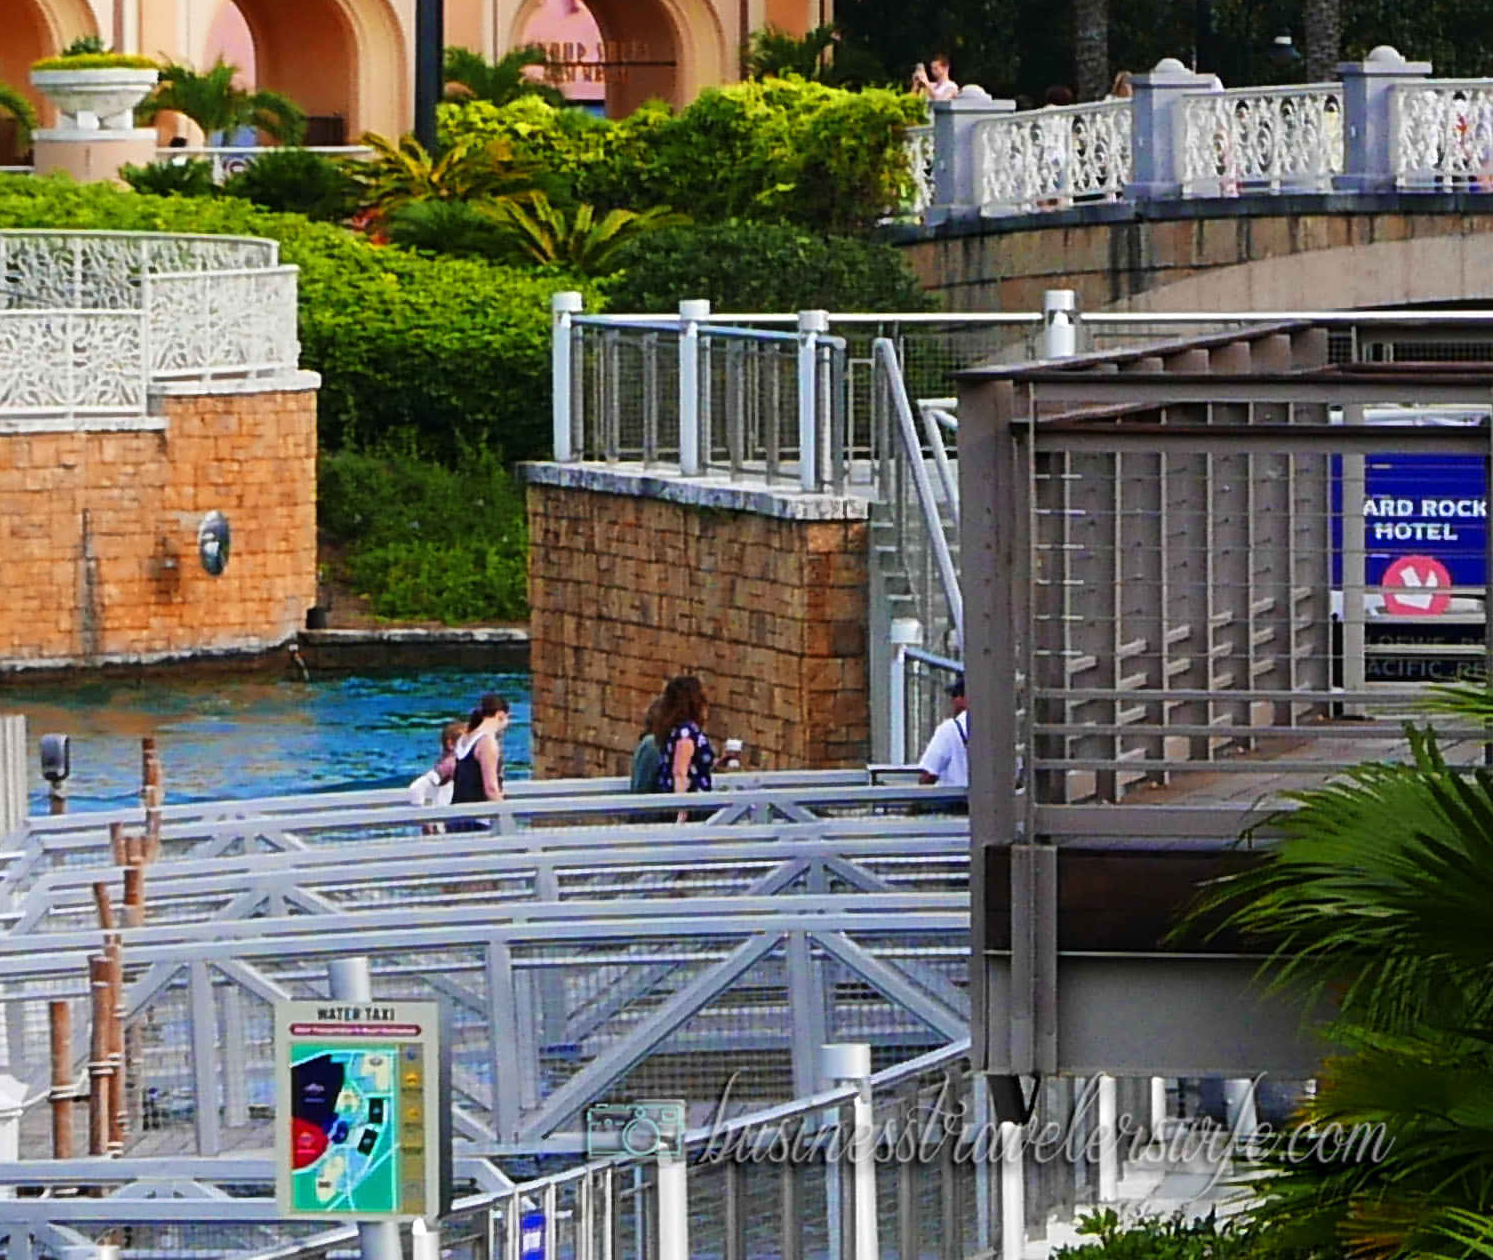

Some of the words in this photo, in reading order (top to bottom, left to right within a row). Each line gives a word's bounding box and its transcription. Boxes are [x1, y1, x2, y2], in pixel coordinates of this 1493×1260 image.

[1363, 500, 1413, 517] ARD
[1420, 500, 1486, 518] ROCK
[1373, 523, 1459, 541] HOTEL
[317, 1007, 360, 1021] WATER
[364, 1007, 396, 1021] TAXI
